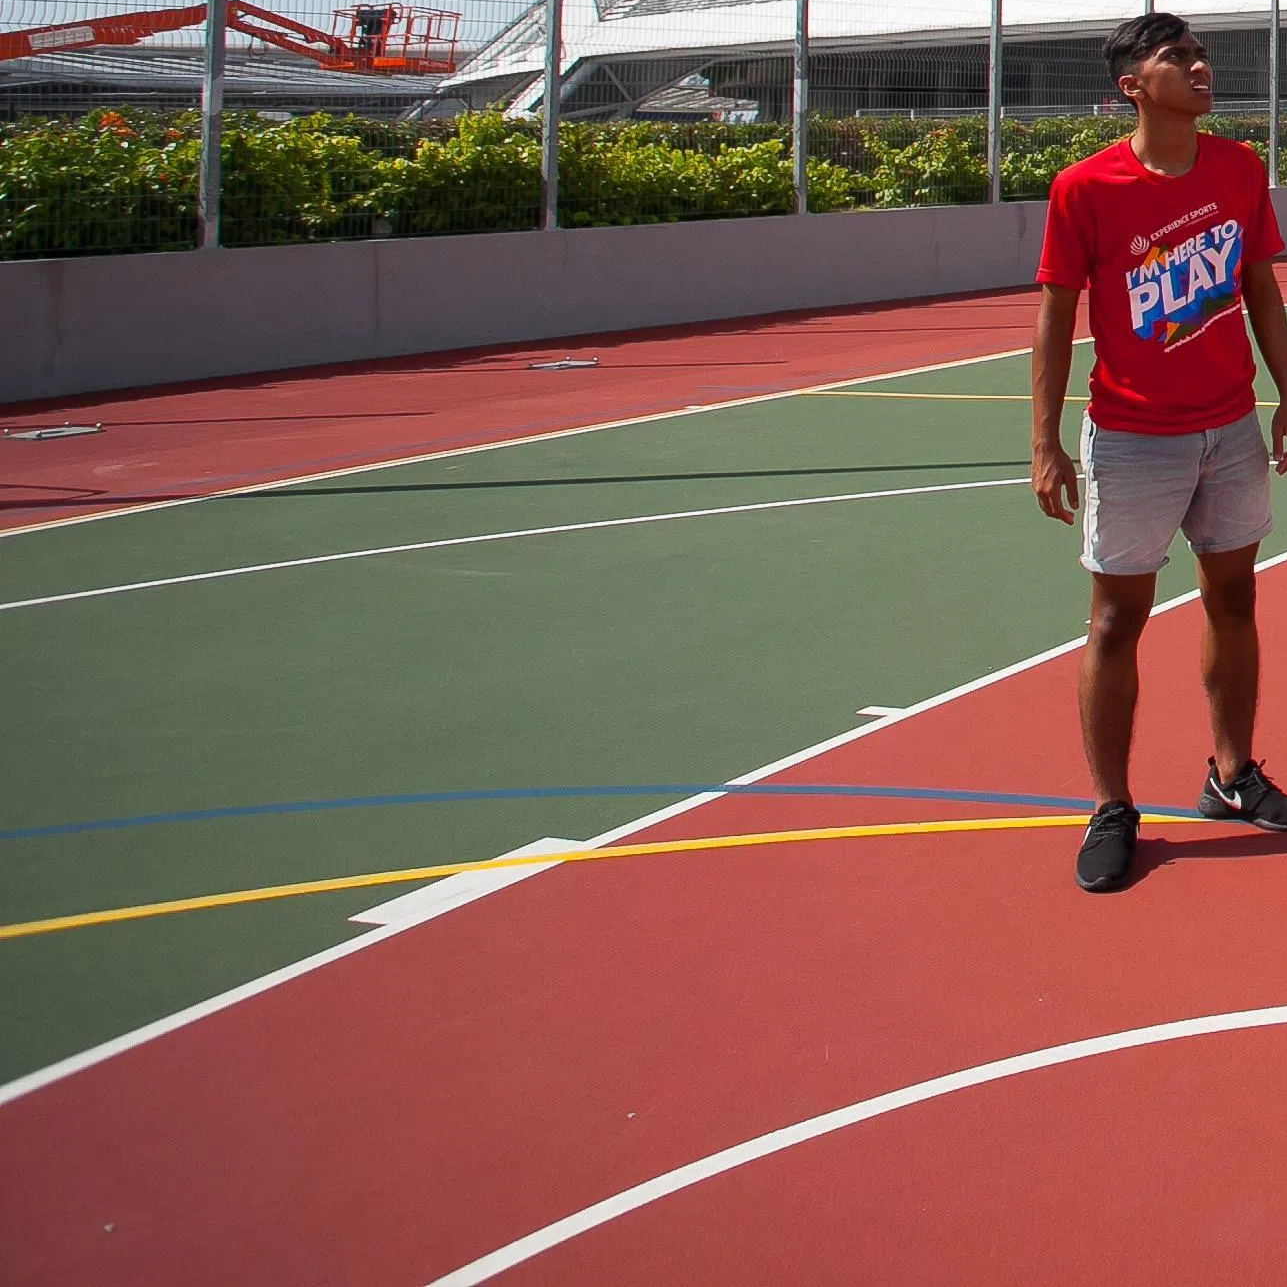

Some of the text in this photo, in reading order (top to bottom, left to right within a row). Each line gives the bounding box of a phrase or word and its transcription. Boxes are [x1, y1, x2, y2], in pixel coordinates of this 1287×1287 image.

[1126, 219, 1238, 290] I'M HERE TO
[1150, 214, 1190, 241] EXPERIENCE
[1190, 202, 1218, 220] SPORTS
[1128, 237, 1237, 330] PLAY
